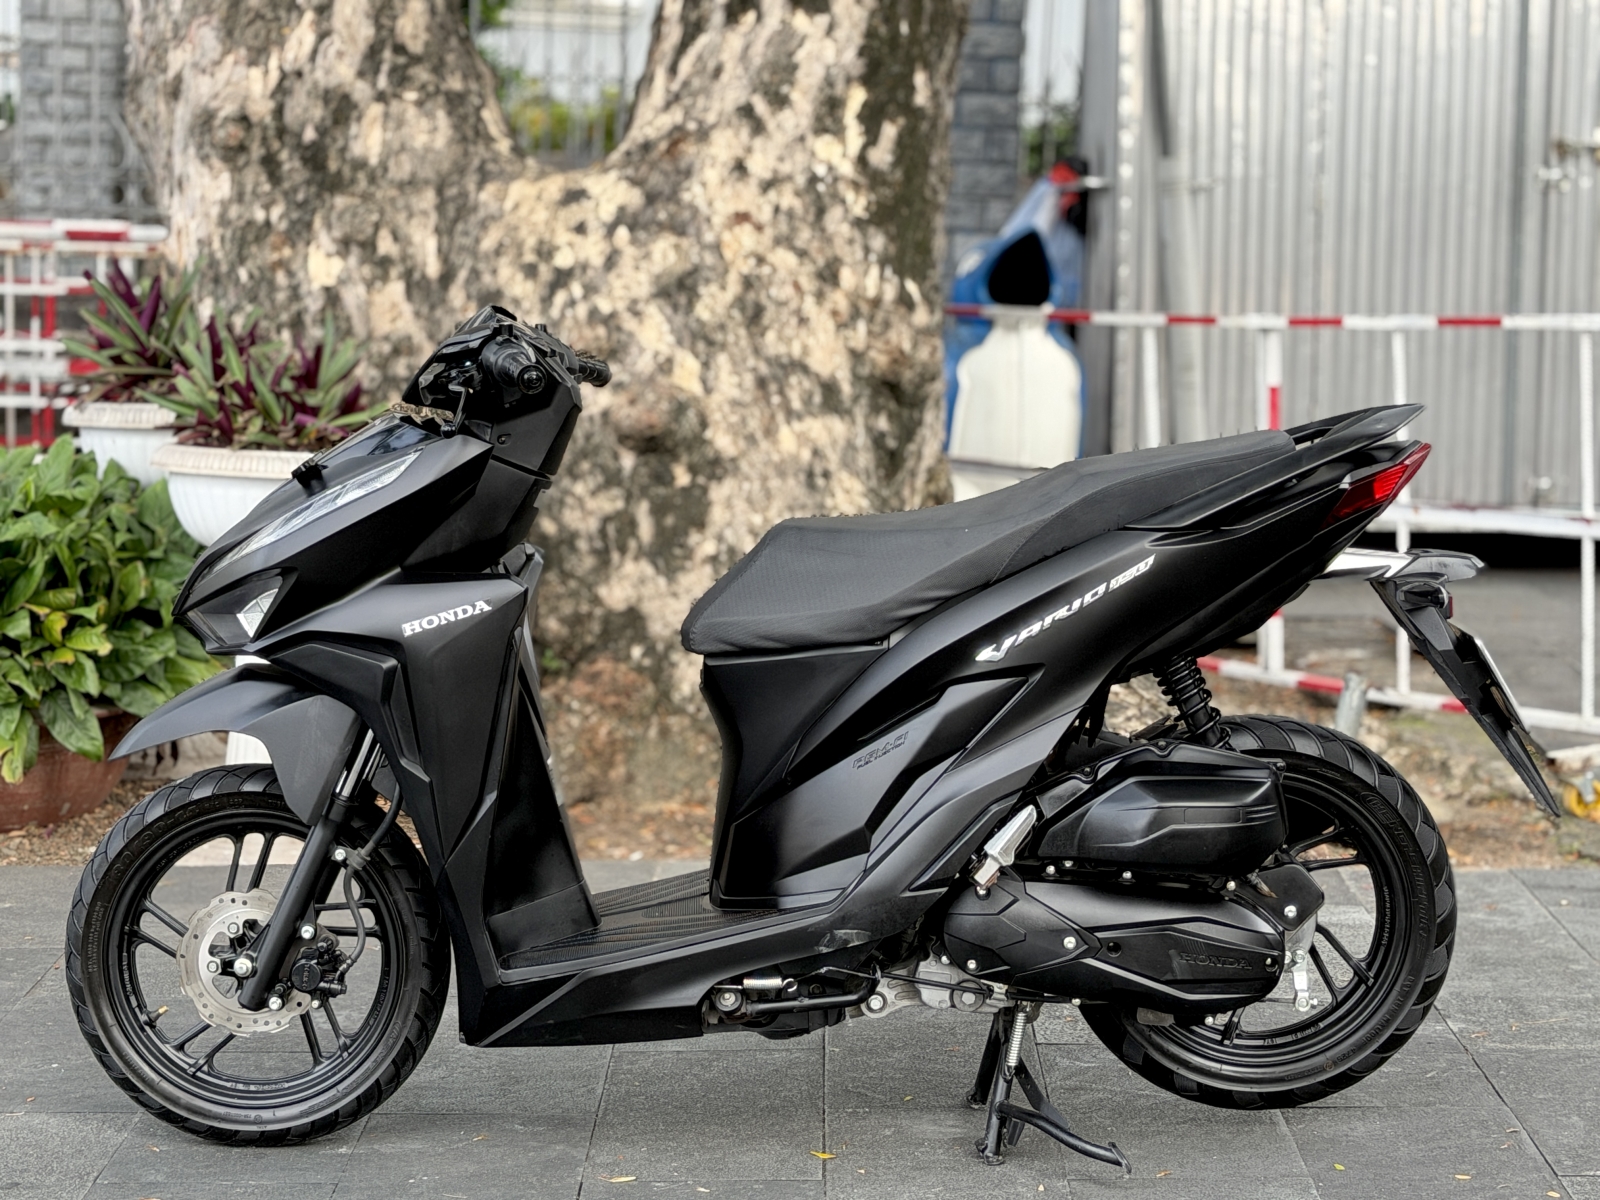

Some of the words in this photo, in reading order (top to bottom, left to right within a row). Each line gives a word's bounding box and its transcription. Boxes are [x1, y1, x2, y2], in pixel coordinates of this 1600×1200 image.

[401, 599, 492, 638] HONDA
[975, 582, 1107, 662] VARIO
[1108, 553, 1156, 592] 150
[1179, 952, 1253, 970] HONDA
